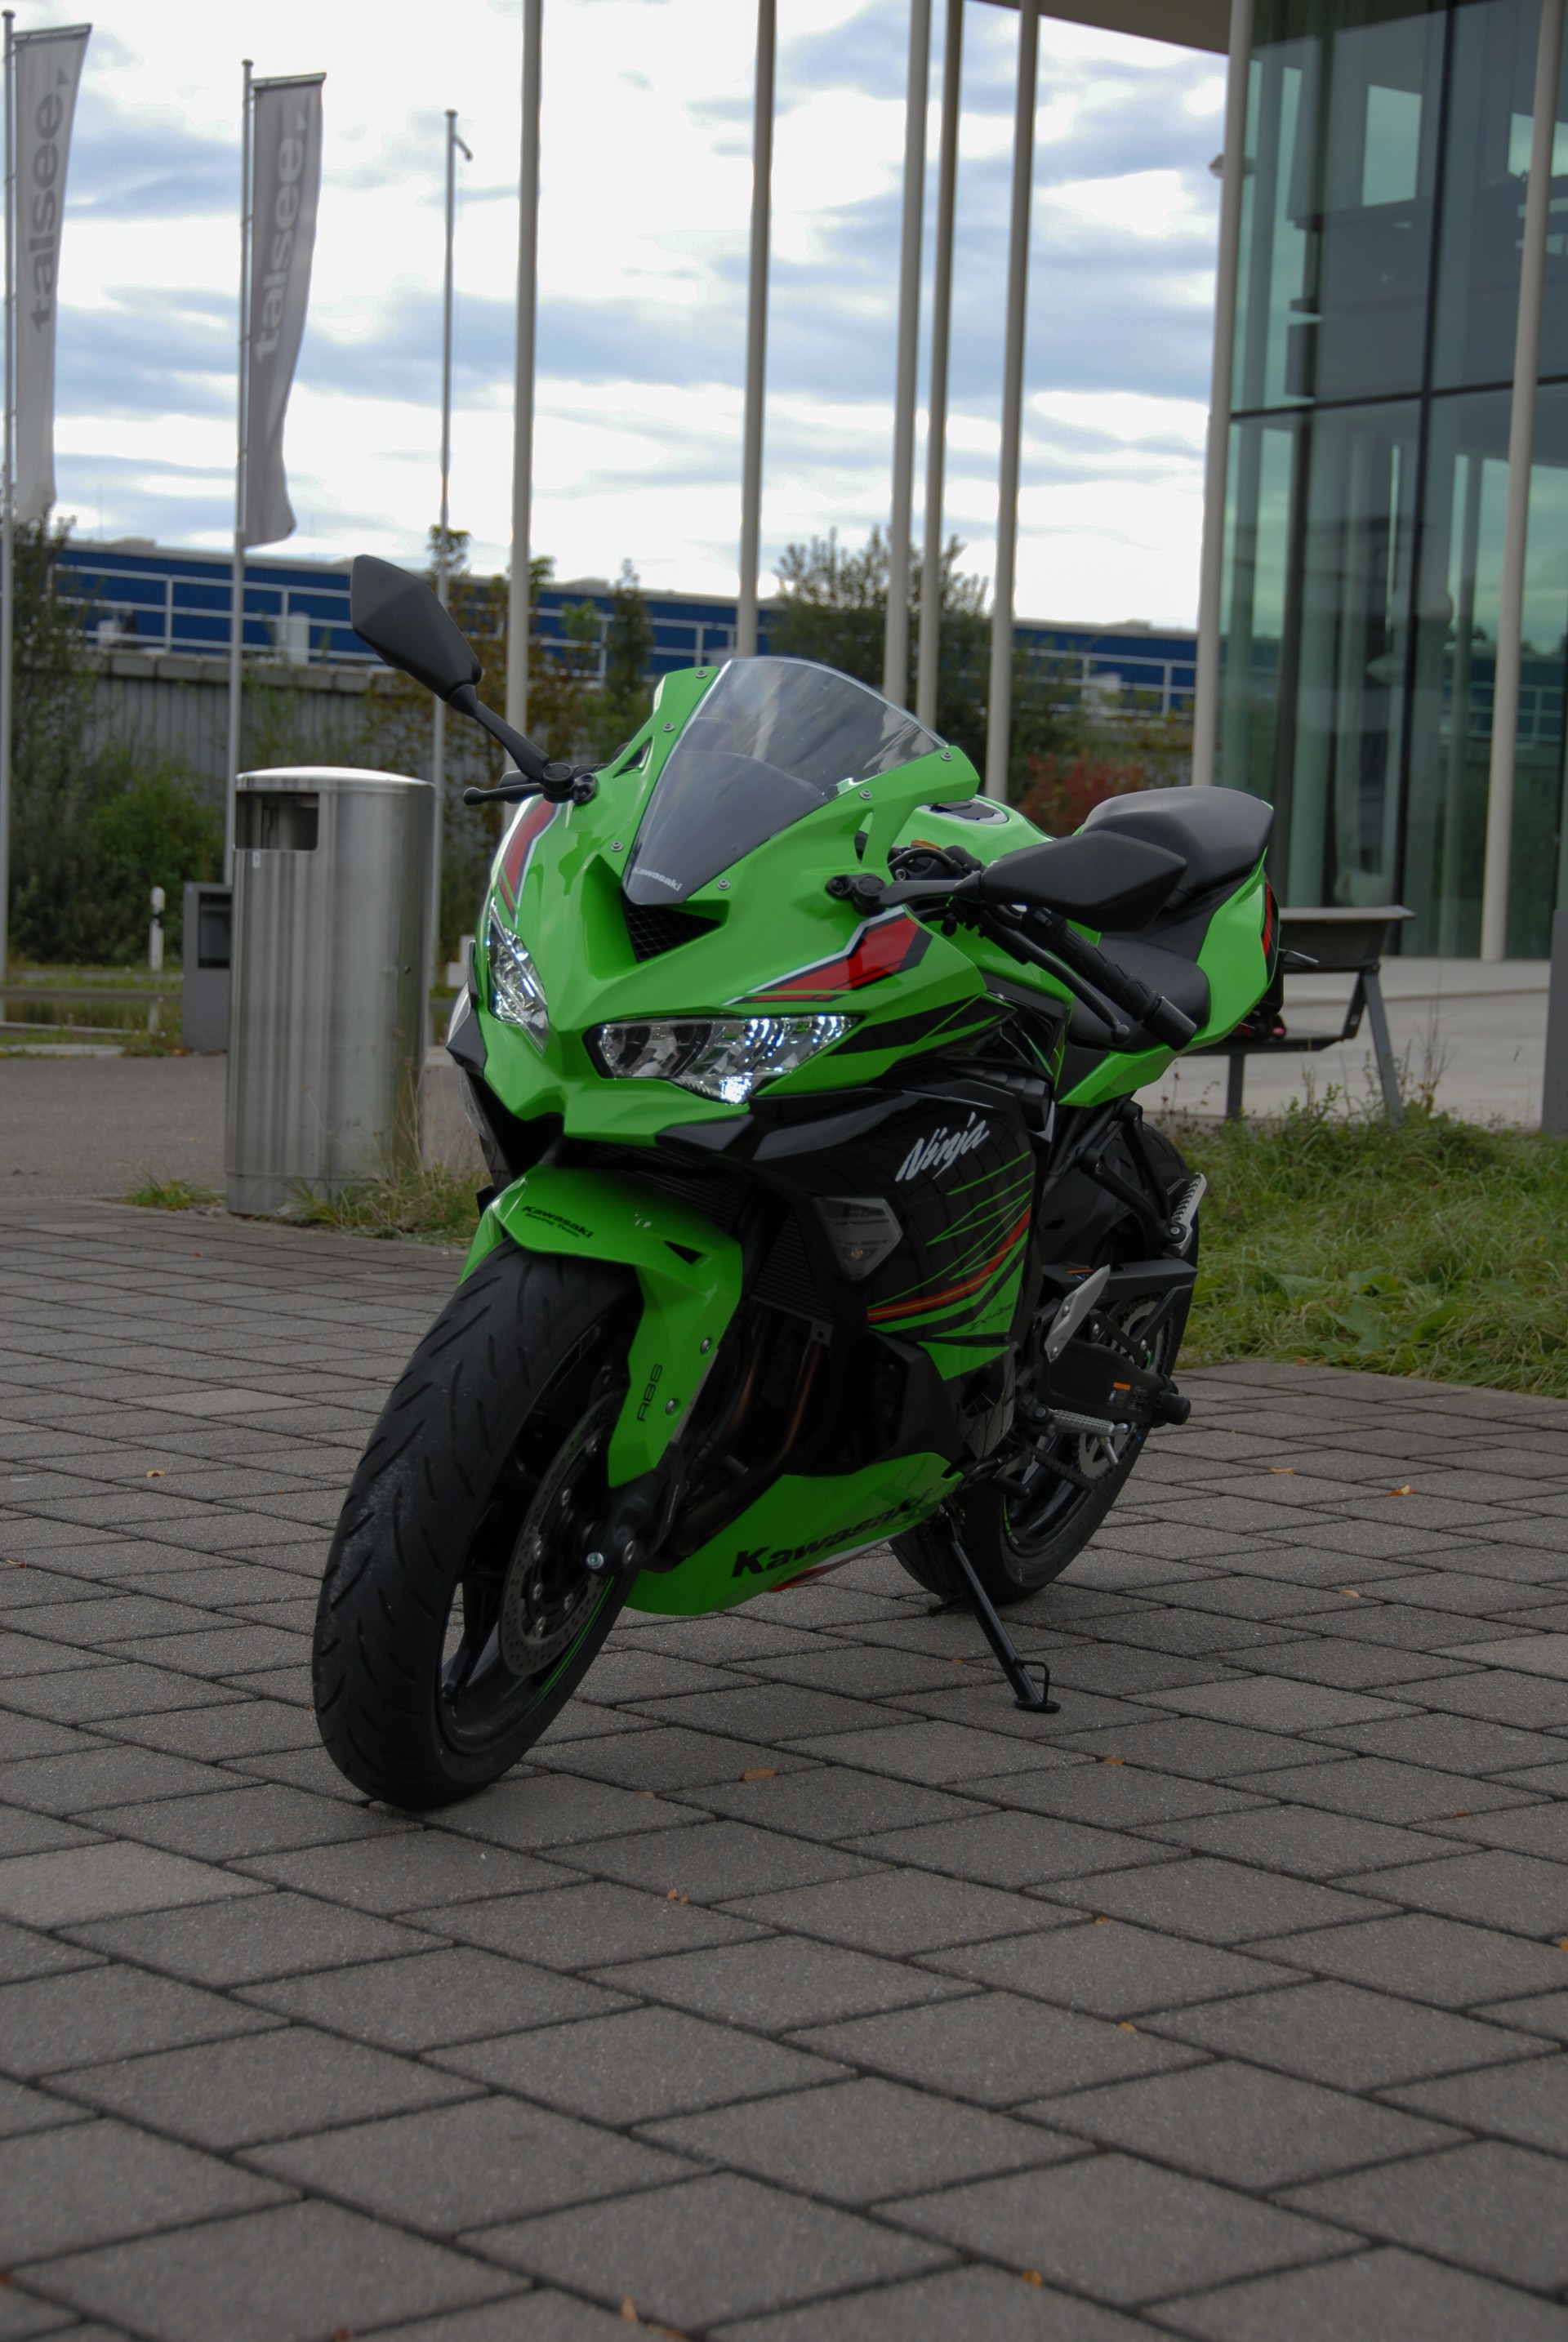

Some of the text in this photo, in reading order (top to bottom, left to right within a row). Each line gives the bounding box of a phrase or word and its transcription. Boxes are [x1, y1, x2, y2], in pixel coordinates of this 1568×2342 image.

[631, 866, 683, 892] Kawasaki
[895, 1111, 990, 1182] Ninja
[522, 1205, 595, 1238] Kawasaki
[525, 1213, 579, 1238] Racing Team
[637, 1364, 663, 1422] ABS
